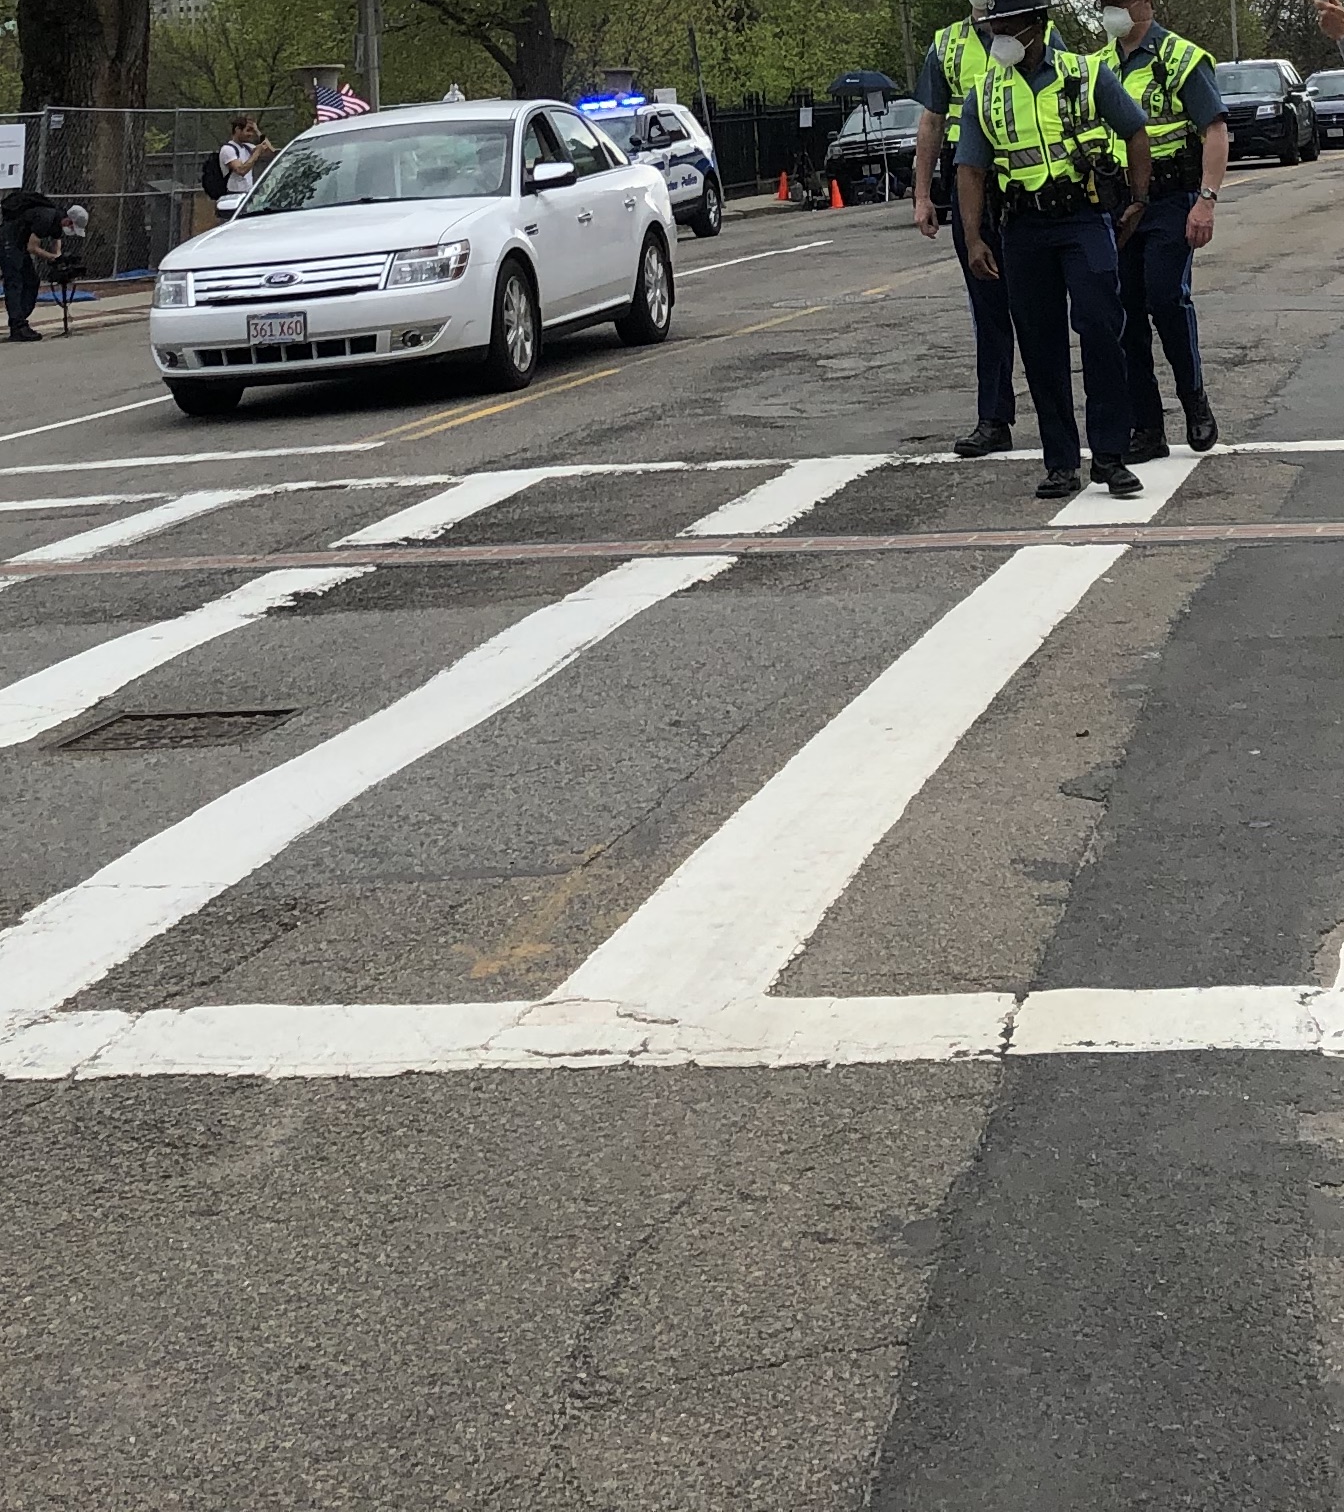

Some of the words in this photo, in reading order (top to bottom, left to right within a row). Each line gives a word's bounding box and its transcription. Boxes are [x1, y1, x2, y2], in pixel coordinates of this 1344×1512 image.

[993, 75, 1004, 129] STATE
[250, 321, 275, 339] 361
[279, 319, 303, 337] X60
